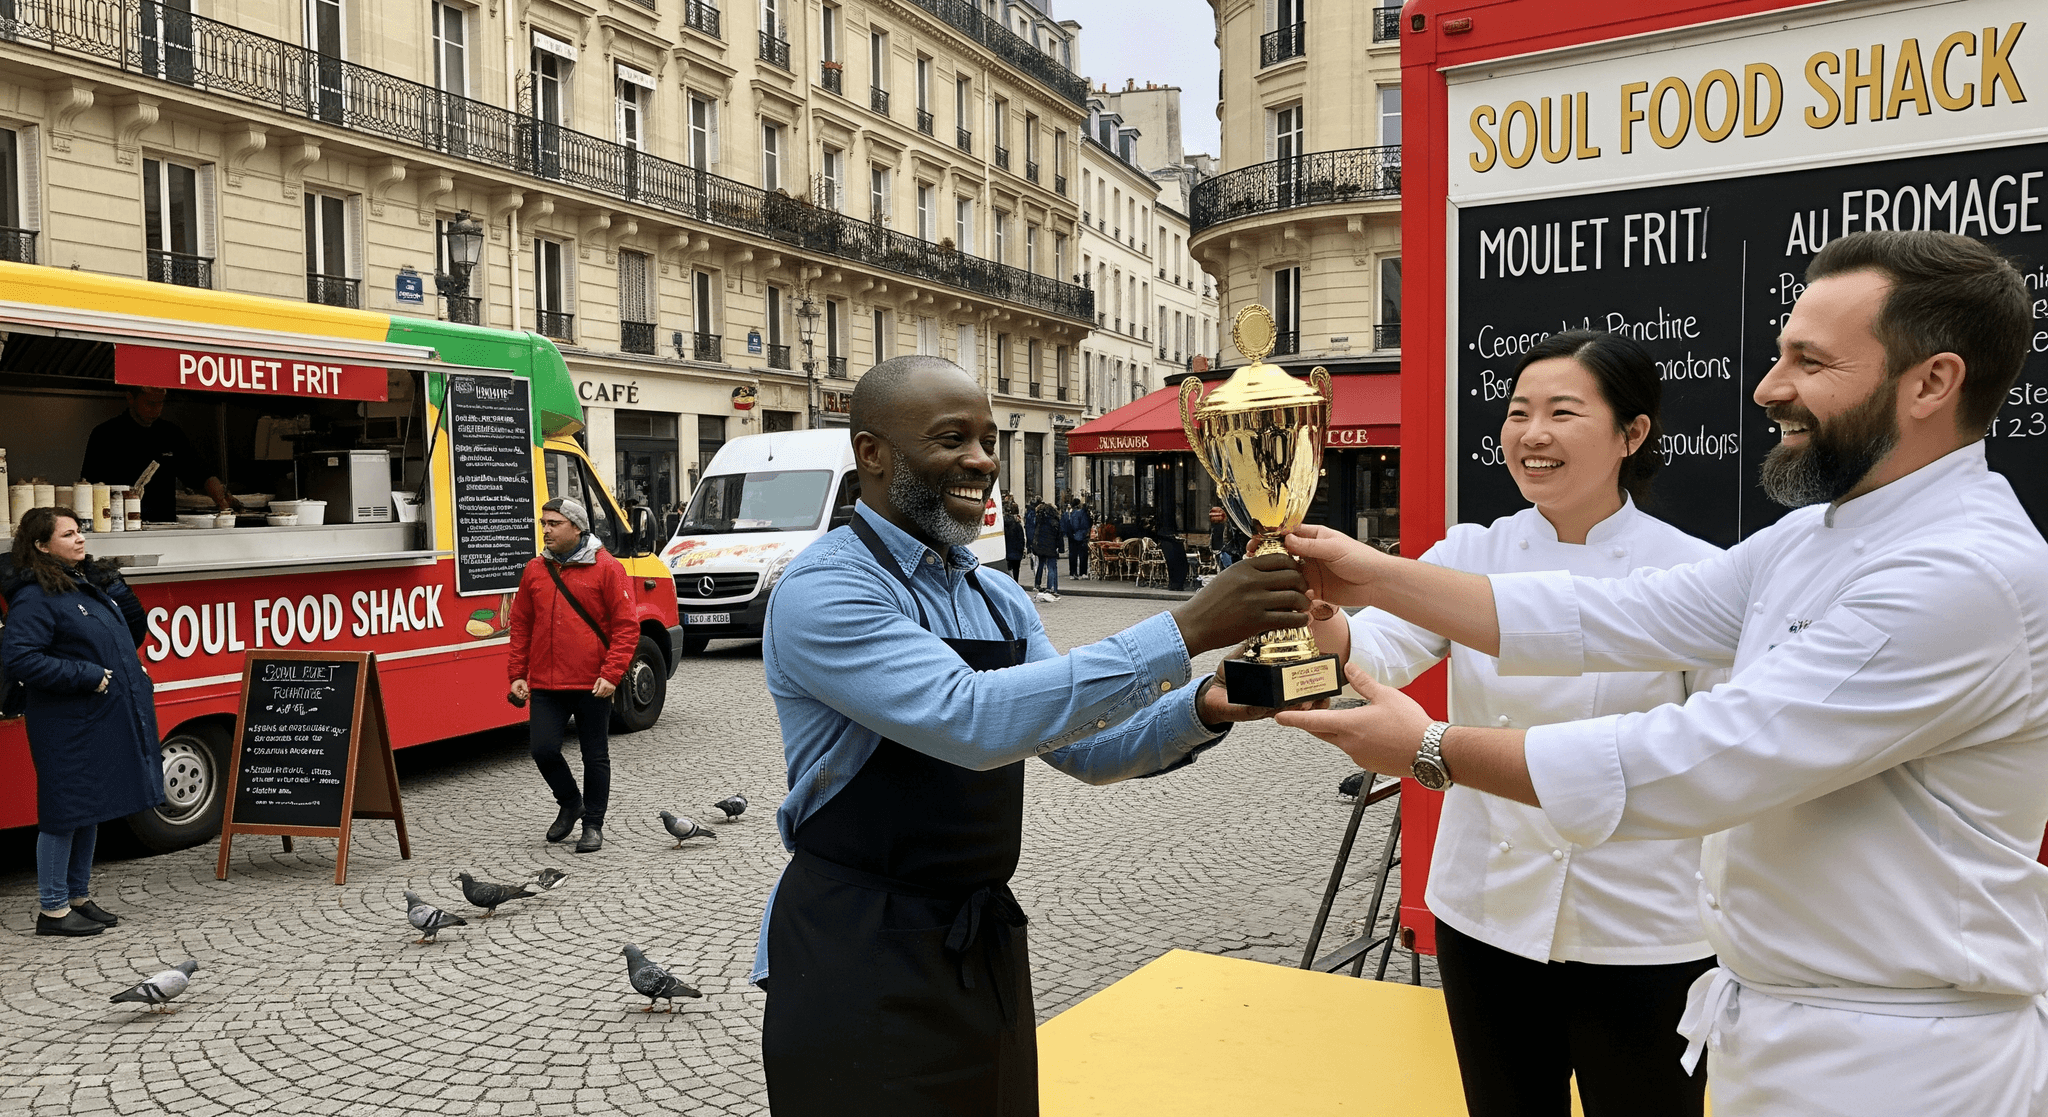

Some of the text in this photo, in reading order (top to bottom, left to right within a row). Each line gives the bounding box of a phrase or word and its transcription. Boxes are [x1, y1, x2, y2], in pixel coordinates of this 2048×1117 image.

[1469, 21, 2028, 173] SOUL FOOD SHACK
[1479, 217, 1609, 280] MOULET
[1785, 171, 2044, 256] AU FROMAGE
[179, 353, 342, 395] POULET FRIT
[578, 381, 640, 404] CAFÉ
[146, 584, 444, 662] SOUL FOOD SHACK
